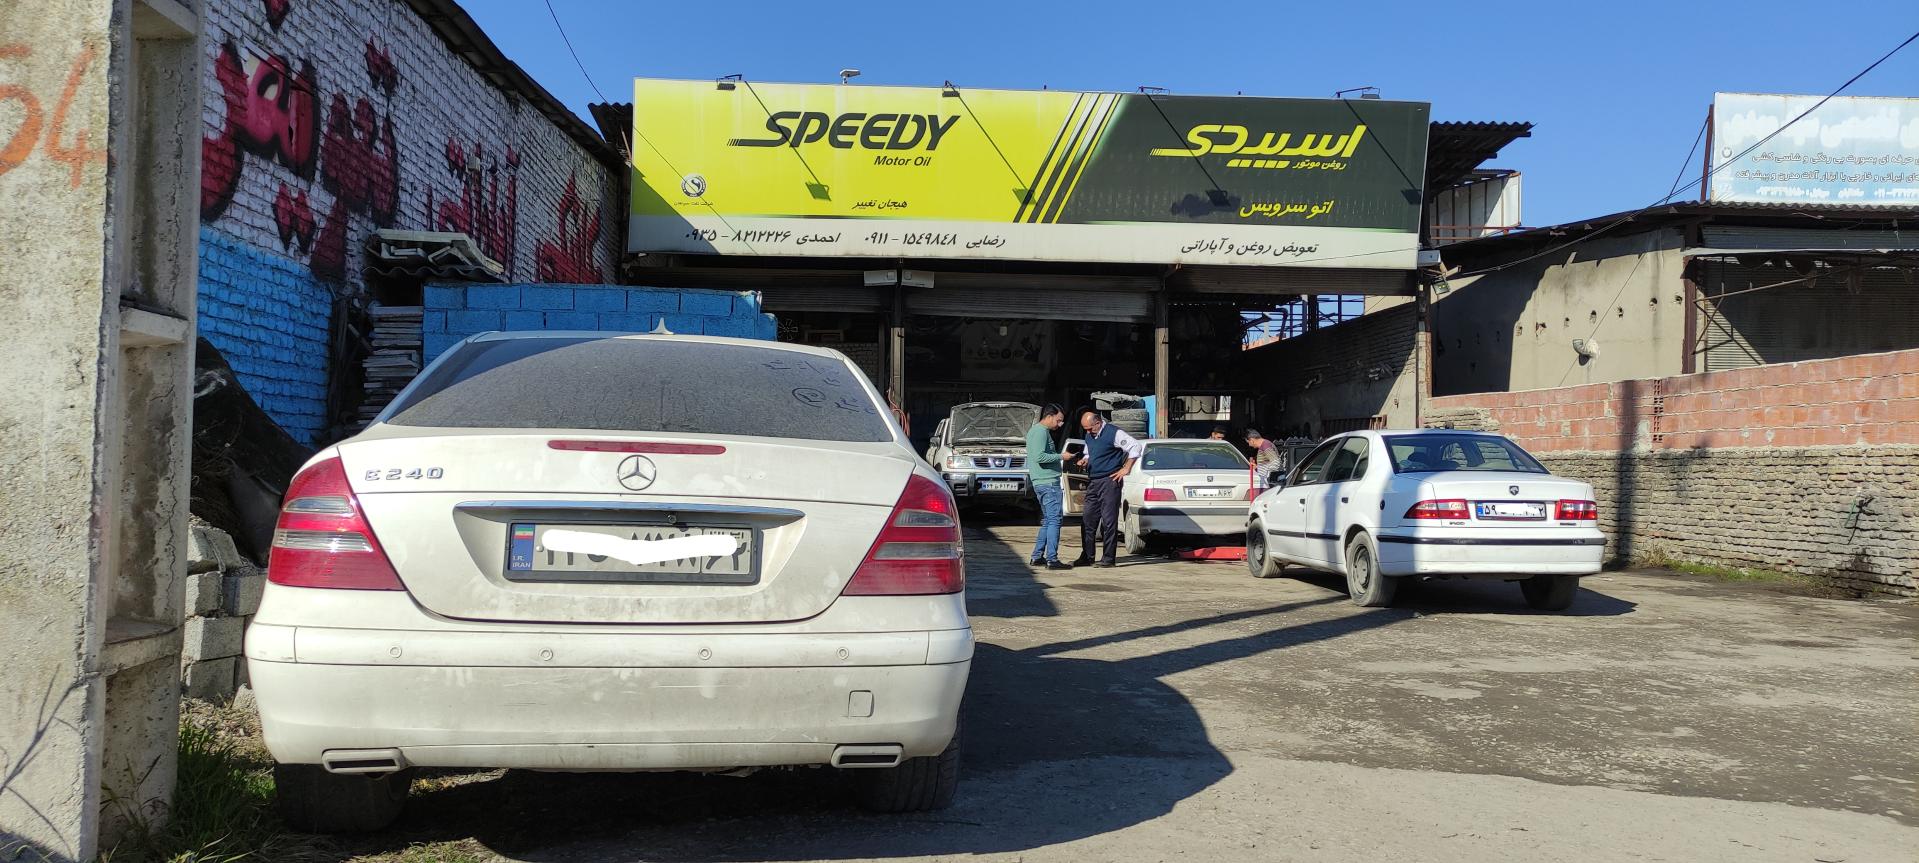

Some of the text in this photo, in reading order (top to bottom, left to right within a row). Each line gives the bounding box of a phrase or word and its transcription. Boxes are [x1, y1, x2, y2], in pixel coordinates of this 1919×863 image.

[727, 111, 961, 151] SPEEDY
[1150, 124, 1367, 169] اسپیدی
[874, 155, 932, 167] Motor Oil
[1293, 159, 1347, 170] روغن موتور
[852, 199, 908, 210] هیجان تغییر
[1239, 200, 1334, 219] اتو سرویس
[796, 232, 842, 245] احمدی
[966, 235, 1006, 248] رضایی
[1181, 238, 1319, 257] تعویض روغن و آپاراتی
[365, 467, 444, 481] E 240
